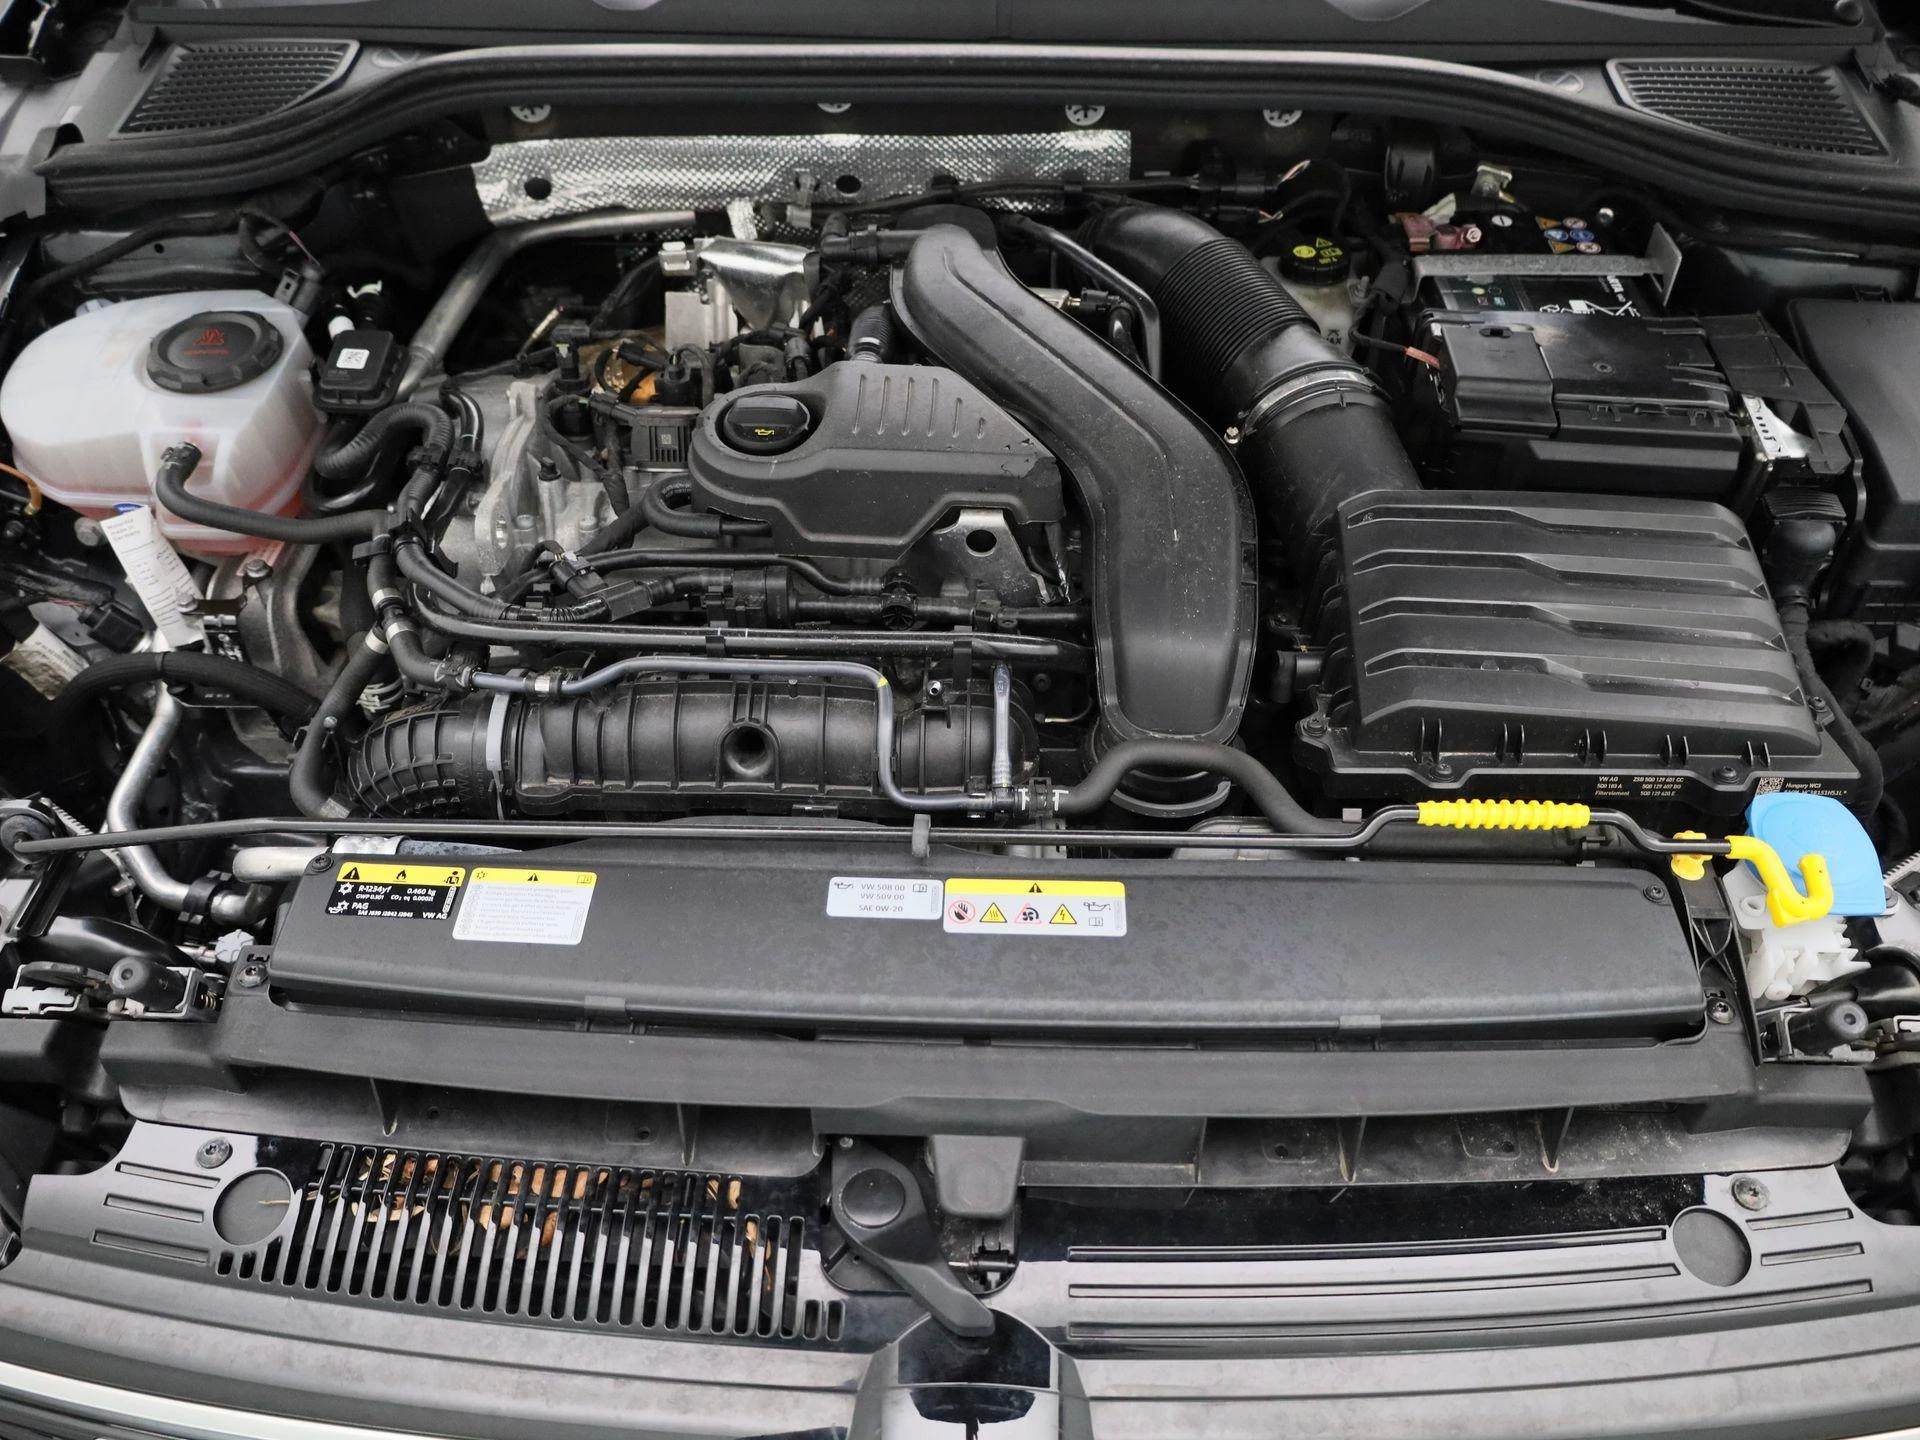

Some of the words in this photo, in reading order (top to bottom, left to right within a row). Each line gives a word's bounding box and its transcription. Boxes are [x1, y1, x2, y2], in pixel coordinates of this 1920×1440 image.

[358, 885, 392, 894] R-1234yf
[427, 889, 437, 897] kg
[351, 902, 370, 910] PAG
